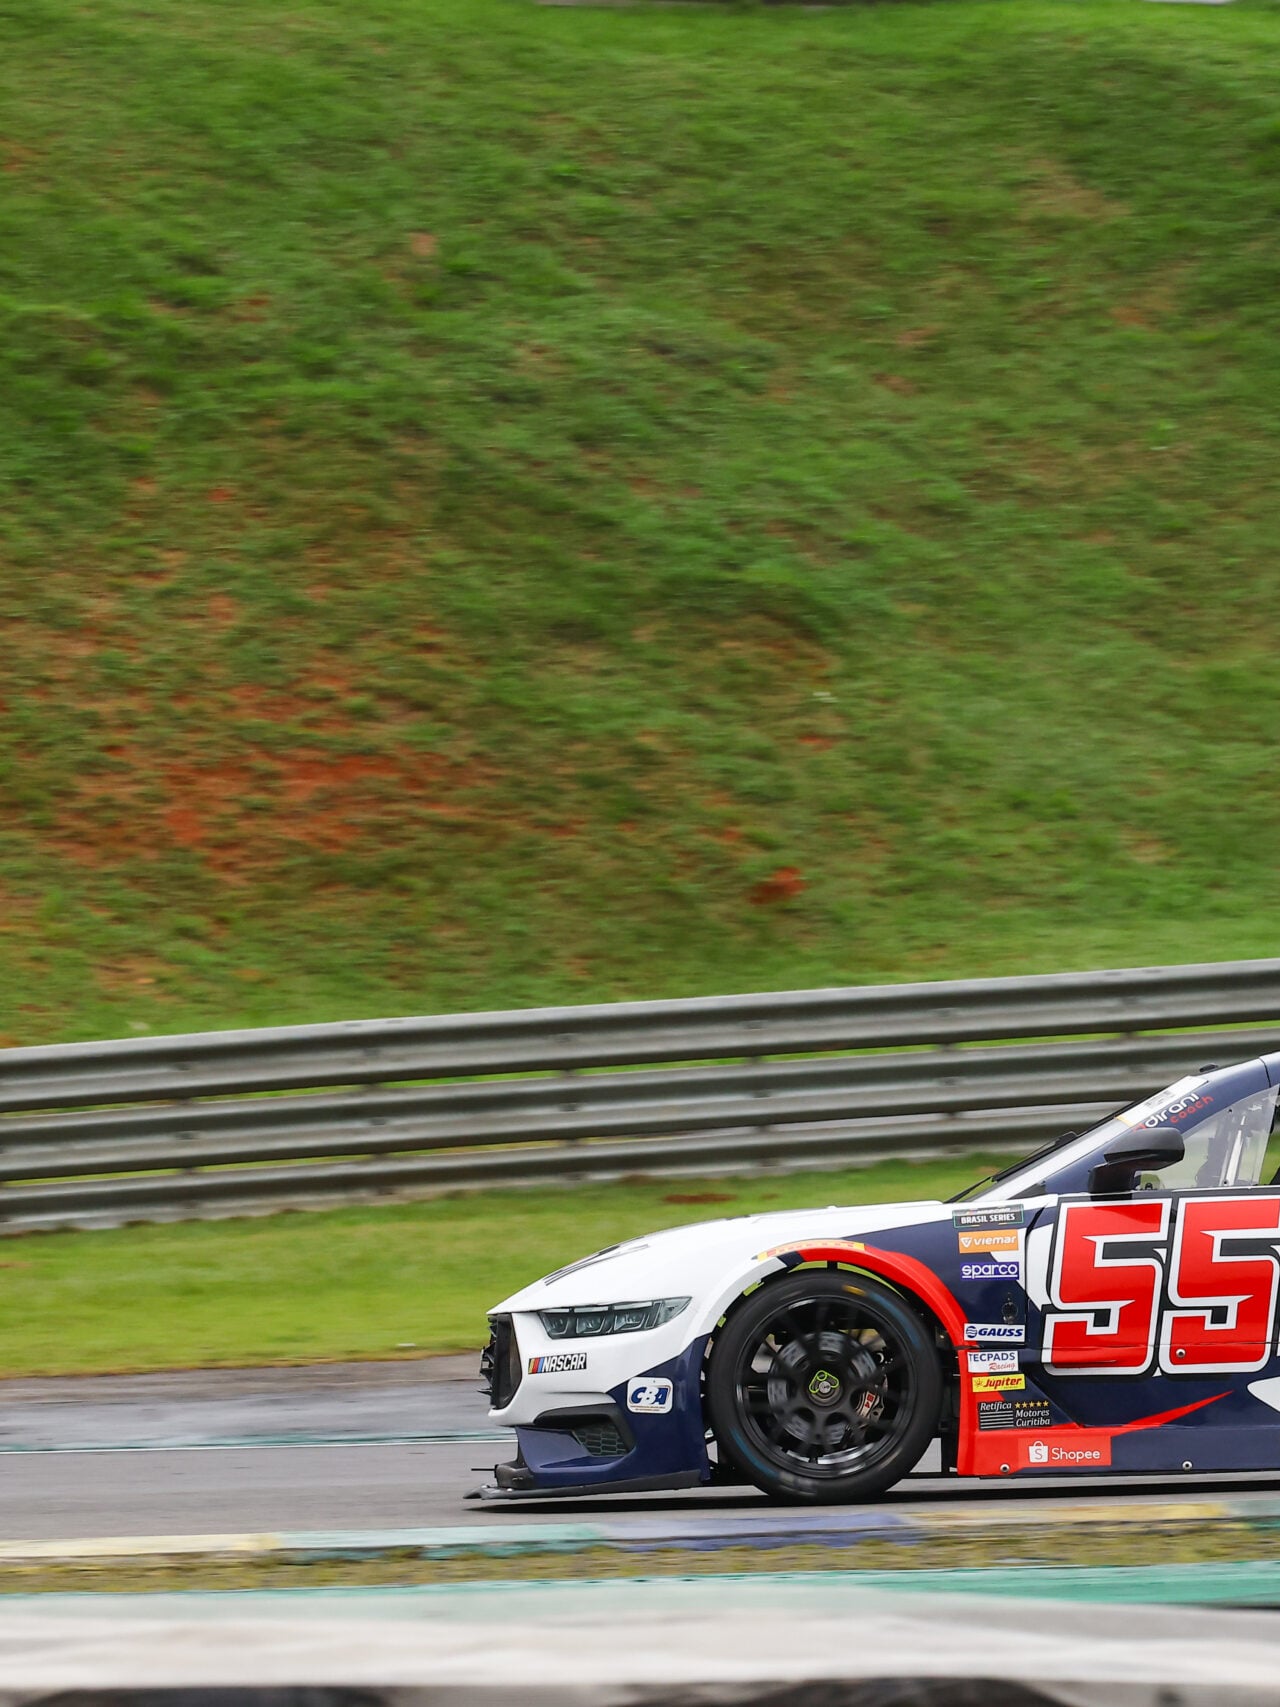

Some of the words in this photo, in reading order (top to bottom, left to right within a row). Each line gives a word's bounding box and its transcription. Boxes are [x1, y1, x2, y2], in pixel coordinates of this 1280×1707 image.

[1145, 1093, 1200, 1128] dirani
[1169, 1096, 1214, 1124] coach
[960, 1215, 988, 1225] BRASIL
[989, 1213, 1016, 1222] SERIES
[961, 1264, 1018, 1279] sparco
[978, 1327, 1024, 1337] GAUSS
[542, 1354, 587, 1372] NASCAR
[969, 1352, 1016, 1363] TECPADS
[988, 1362, 1016, 1371] Racing
[1015, 1409, 1050, 1418] Motores
[1015, 1417, 1050, 1427] Curitiba
[1051, 1447, 1101, 1463] Shopee
